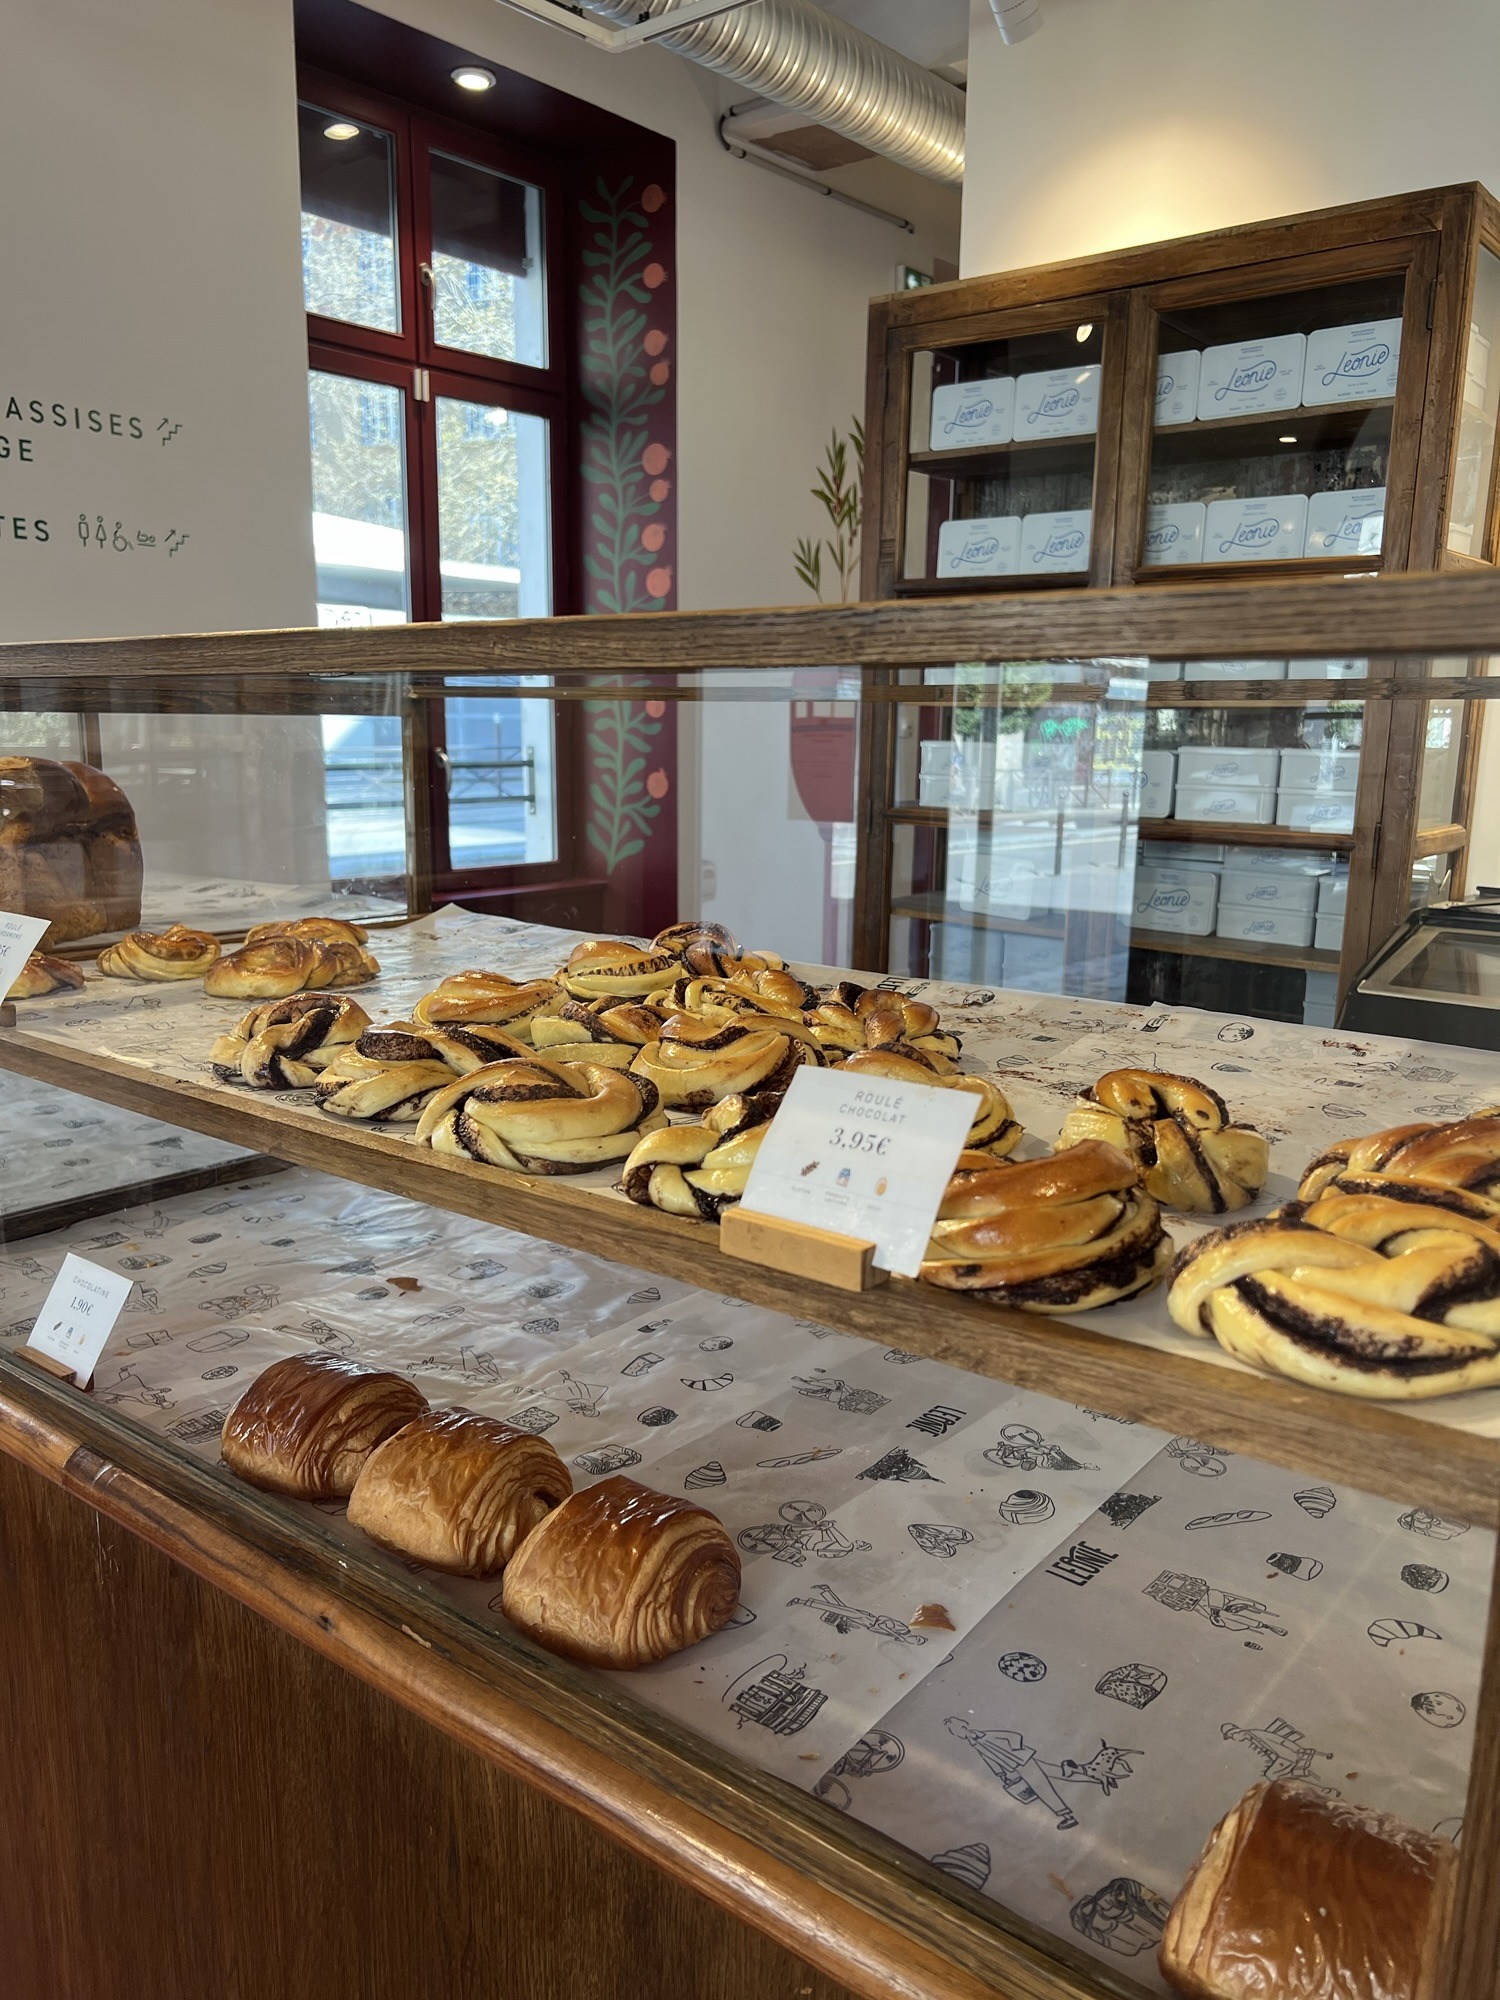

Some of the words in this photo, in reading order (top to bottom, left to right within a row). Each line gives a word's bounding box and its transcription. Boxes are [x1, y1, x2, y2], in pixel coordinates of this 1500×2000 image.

[1214, 359, 1277, 401] Leonie
[1321, 343, 1390, 387] Leonie
[6, 397, 143, 439] ASSISES
[1219, 518, 1280, 554] Leonie
[1137, 888, 1191, 914] Leonie
[839, 1103, 907, 1125] CHOCOLAT
[855, 1090, 904, 1109] ROULÉ
[829, 1126, 892, 1156] 3,95€
[72, 1275, 111, 1299] CHOCOLATINE
